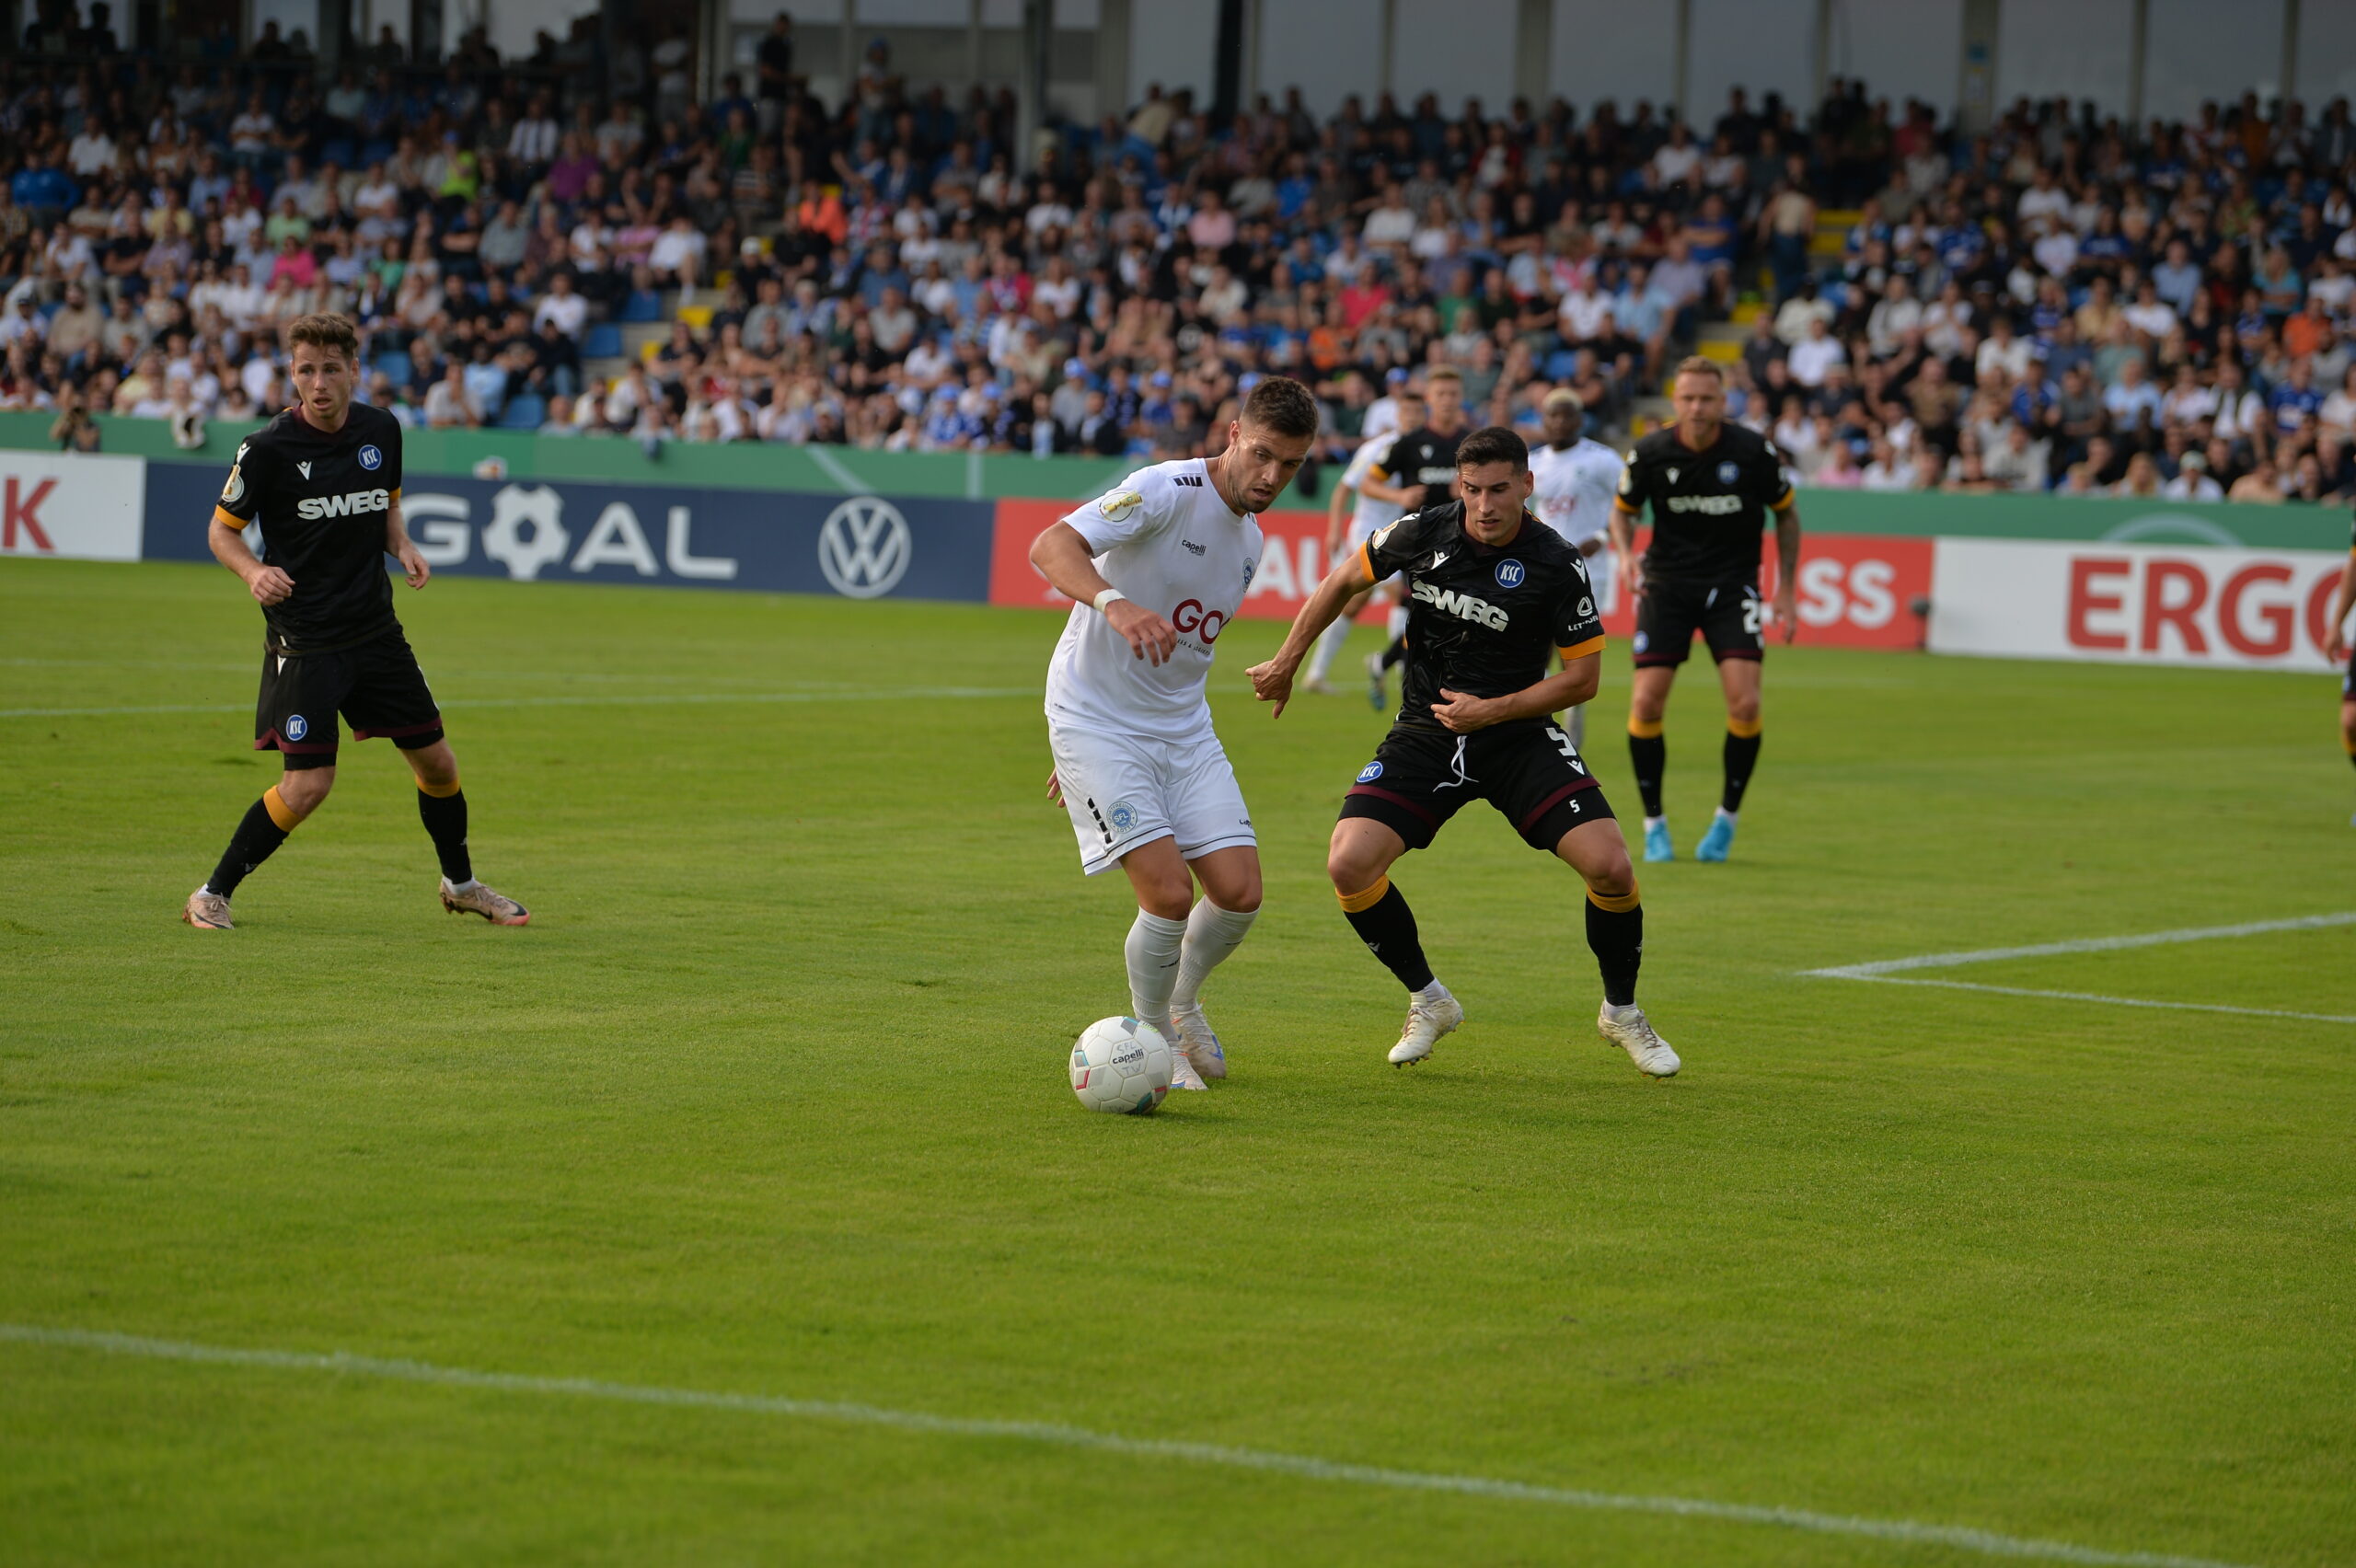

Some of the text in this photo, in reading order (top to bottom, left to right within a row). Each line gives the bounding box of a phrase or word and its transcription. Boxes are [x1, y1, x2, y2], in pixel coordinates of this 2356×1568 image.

[362, 448, 378, 467] KSC
[296, 488, 390, 521] SWEG
[1666, 494, 1743, 515] SWEG
[1181, 538, 1207, 555] capelli
[1499, 564, 1521, 582] KSC
[1411, 579, 1509, 632] SWEG
[288, 720, 303, 735] KSC
[1358, 765, 1380, 779] KSC
[1568, 799, 1581, 813] 5
[1114, 812, 1129, 823] SFL
[1112, 1048, 1145, 1065] capelli
